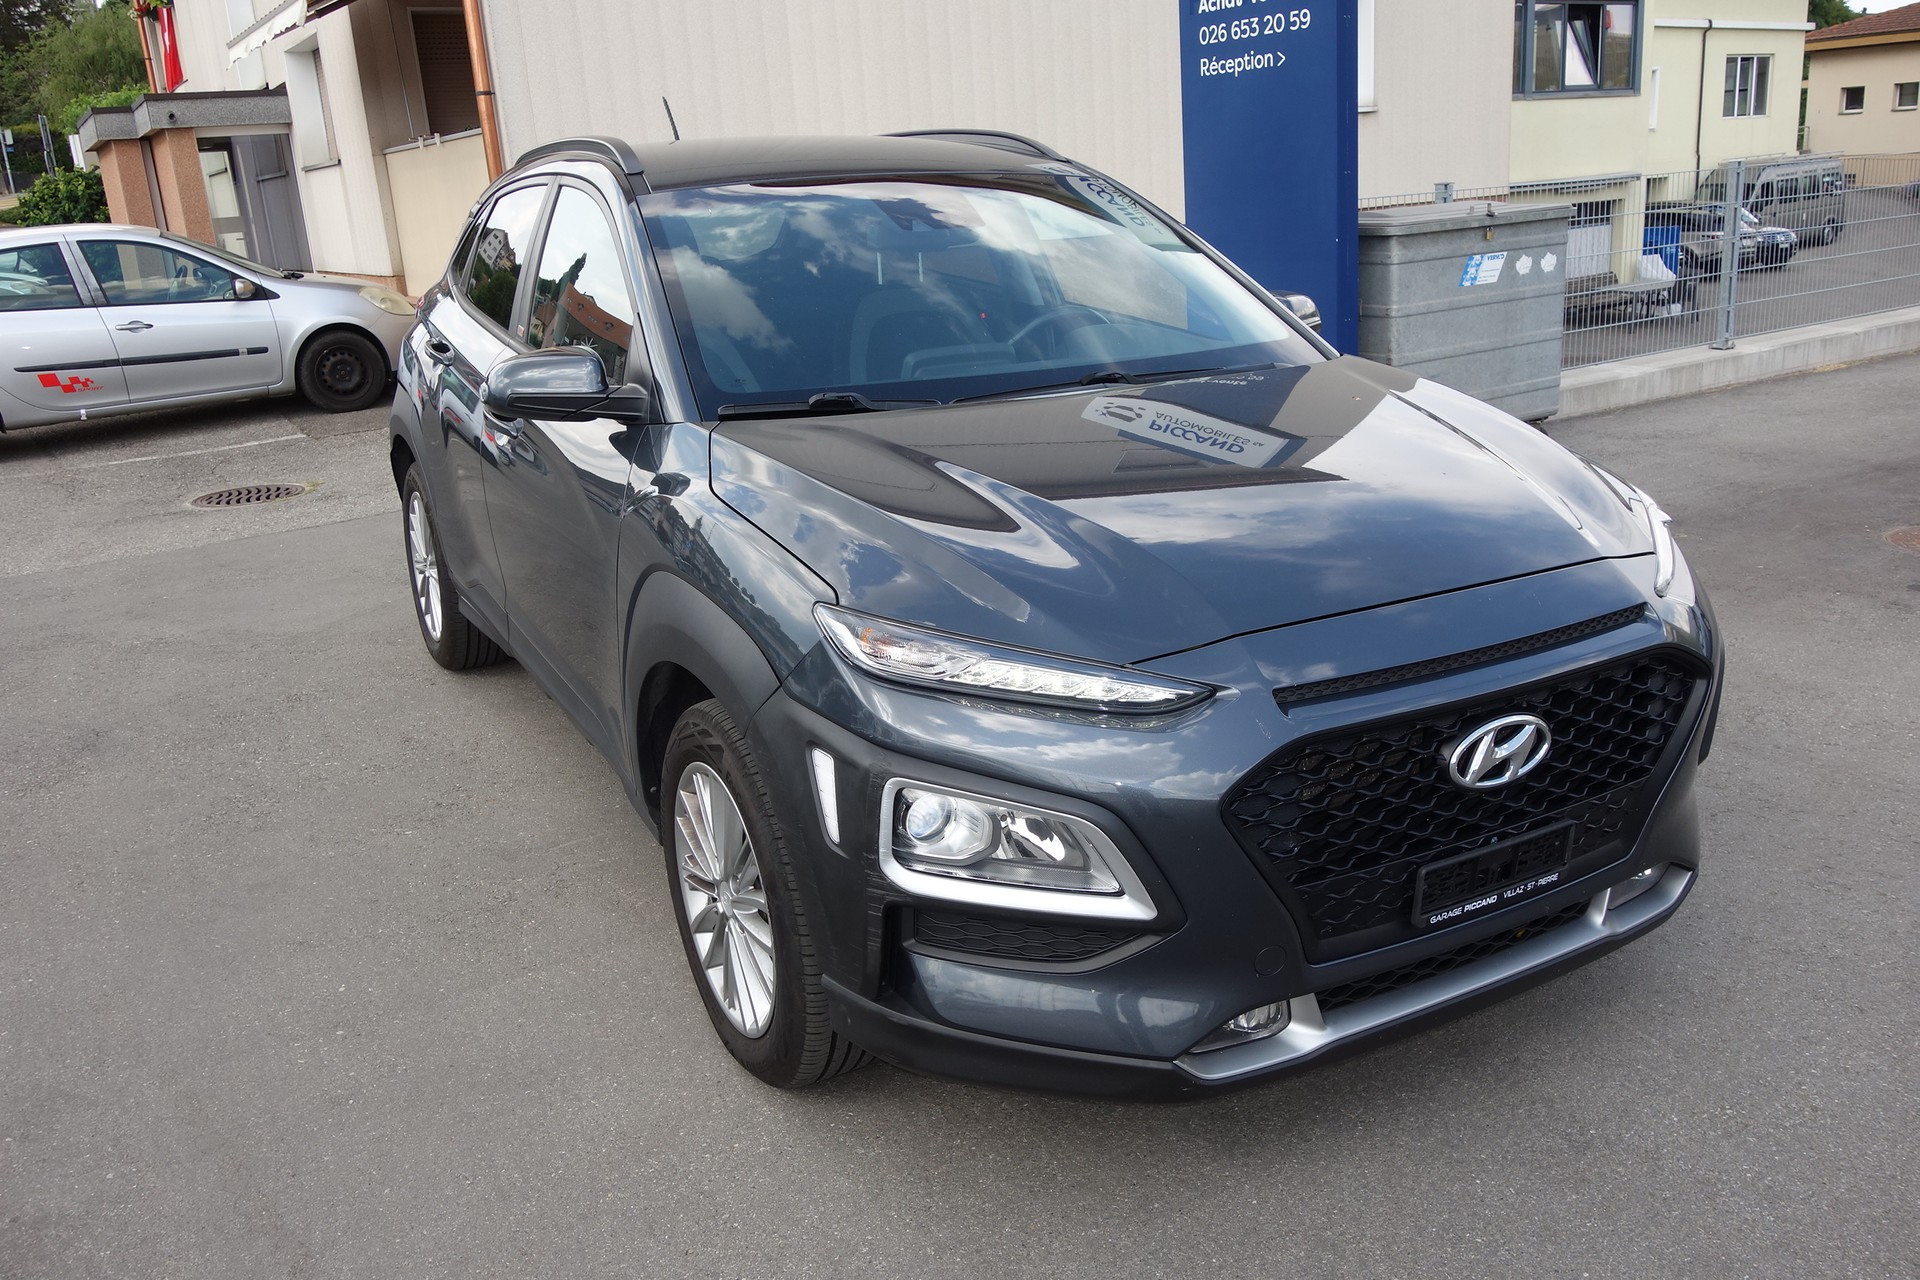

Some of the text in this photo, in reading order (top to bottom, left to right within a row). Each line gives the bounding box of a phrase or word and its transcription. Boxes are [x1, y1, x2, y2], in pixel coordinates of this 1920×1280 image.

[1199, 8, 1312, 46] 026 653 20 59
[1200, 50, 1274, 77] Réception
[1430, 907, 1463, 924] GARAGE
[1464, 895, 1498, 912] PICCAND
